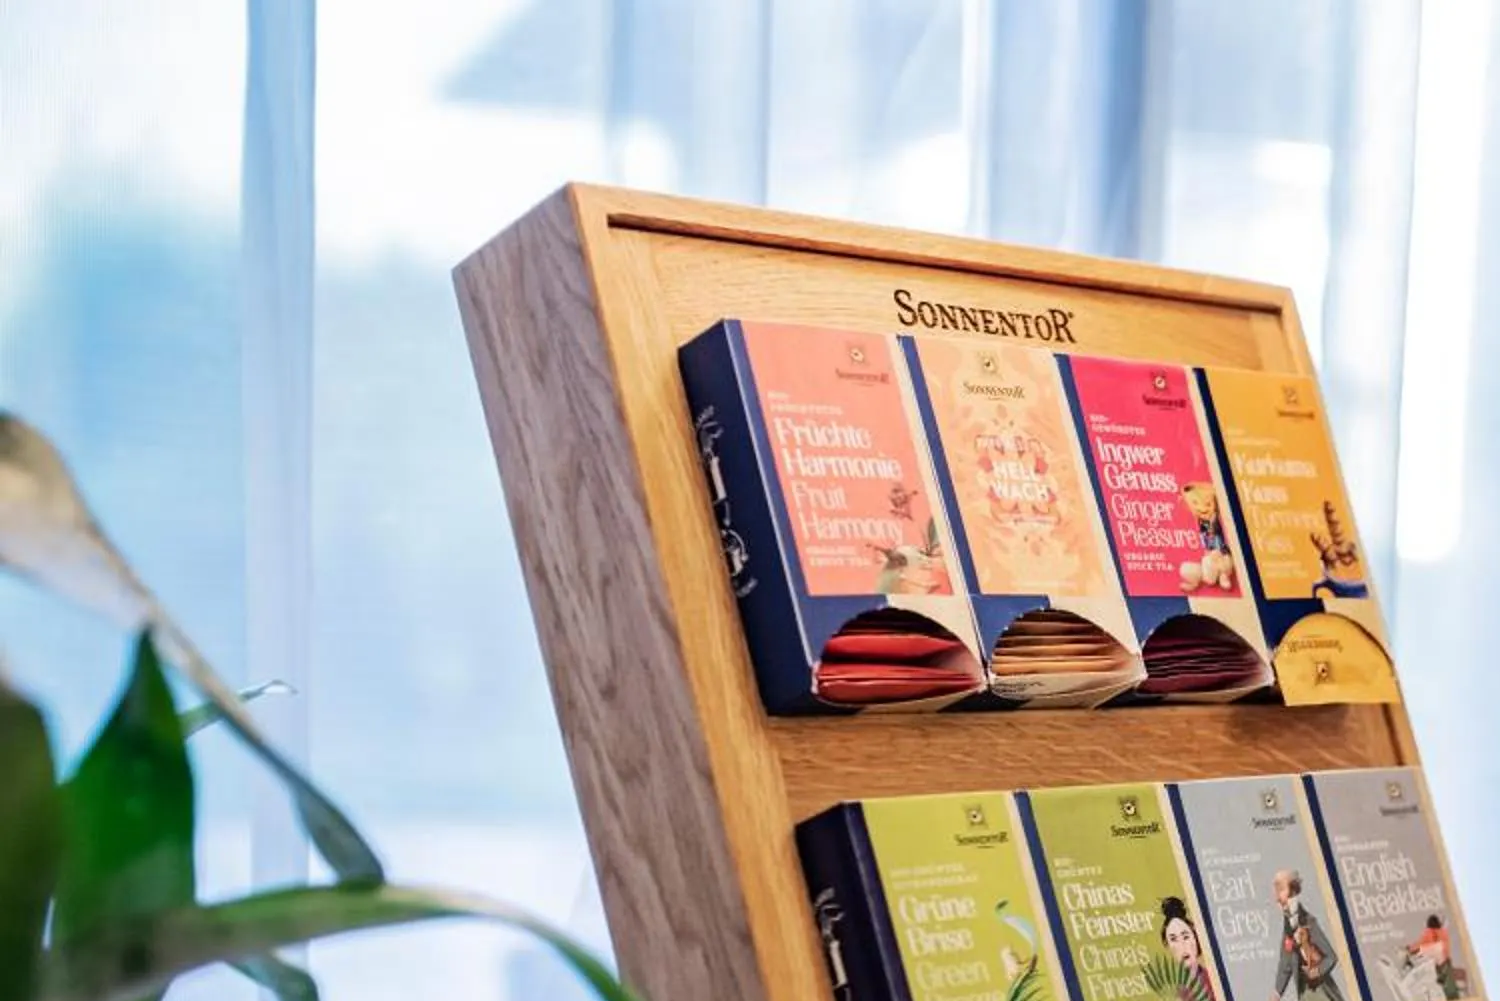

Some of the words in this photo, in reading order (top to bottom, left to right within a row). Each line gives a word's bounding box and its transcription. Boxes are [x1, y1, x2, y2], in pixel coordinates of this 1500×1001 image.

[773, 417, 872, 449] Früchte
[781, 448, 903, 480] Harmonie
[1096, 436, 1165, 470] Ingwer
[791, 480, 848, 509] Fruit
[1103, 463, 1179, 493] Genuss
[1111, 492, 1174, 527] Ginger
[798, 510, 903, 546] Harmony
[1117, 521, 1200, 550] Pleasure
[1209, 868, 1255, 902] Earl
[1341, 850, 1418, 891] English
[899, 894, 977, 925] Grüne
[1062, 881, 1135, 911] Chinas
[1349, 882, 1444, 920] Breakfast
[1068, 909, 1155, 942] Feinster
[1217, 904, 1269, 939] Grey
[905, 923, 974, 957] Brise
[1079, 940, 1150, 973] China's
[915, 961, 991, 991] Green
